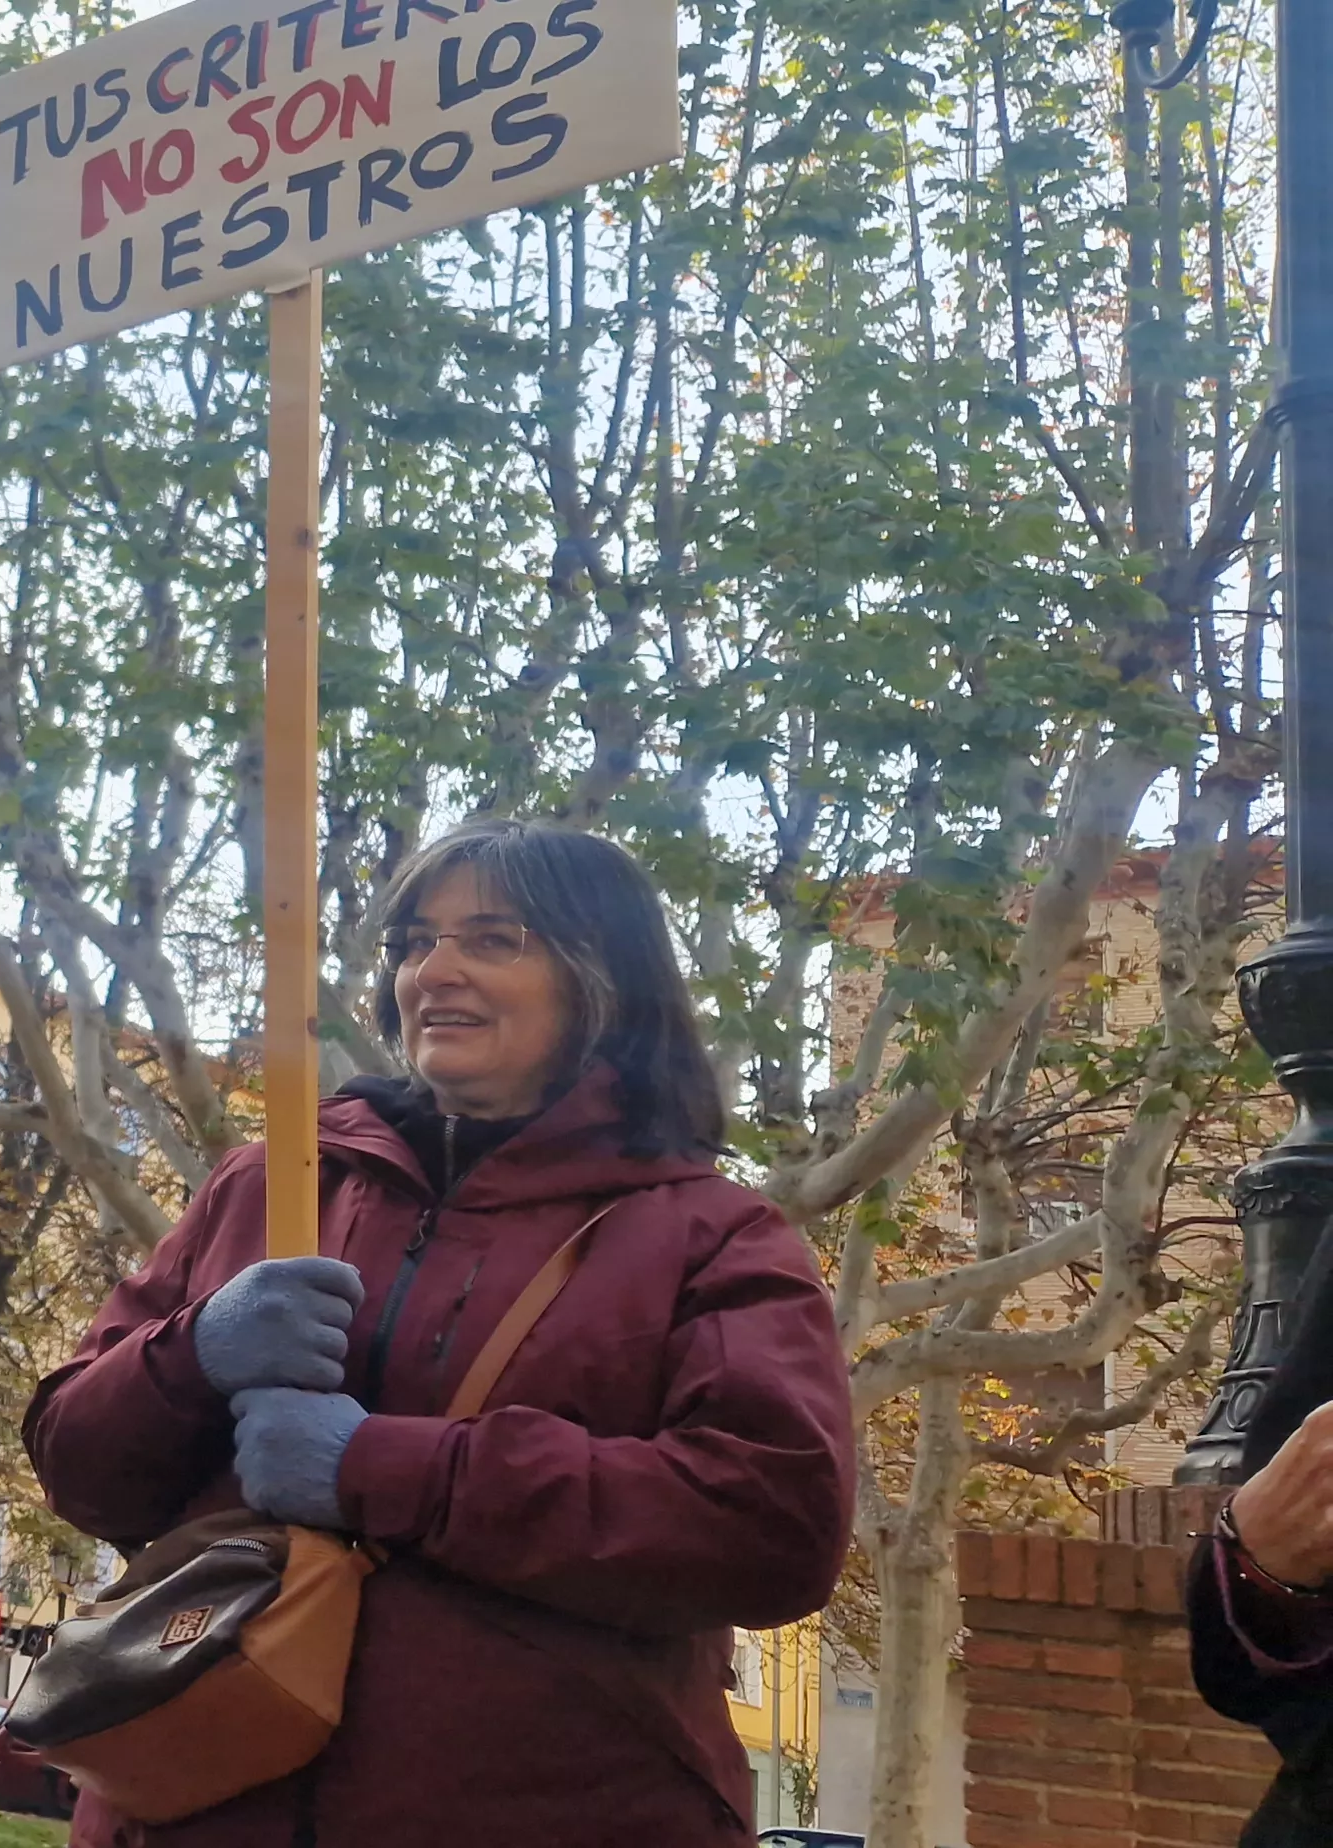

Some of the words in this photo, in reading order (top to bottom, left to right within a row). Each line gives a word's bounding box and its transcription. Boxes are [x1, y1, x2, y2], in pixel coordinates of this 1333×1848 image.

[14, 91, 569, 349] NUESTROS
[80, 128, 196, 241] NO
[219, 59, 397, 184] SON
[436, 0, 604, 111] LOS
